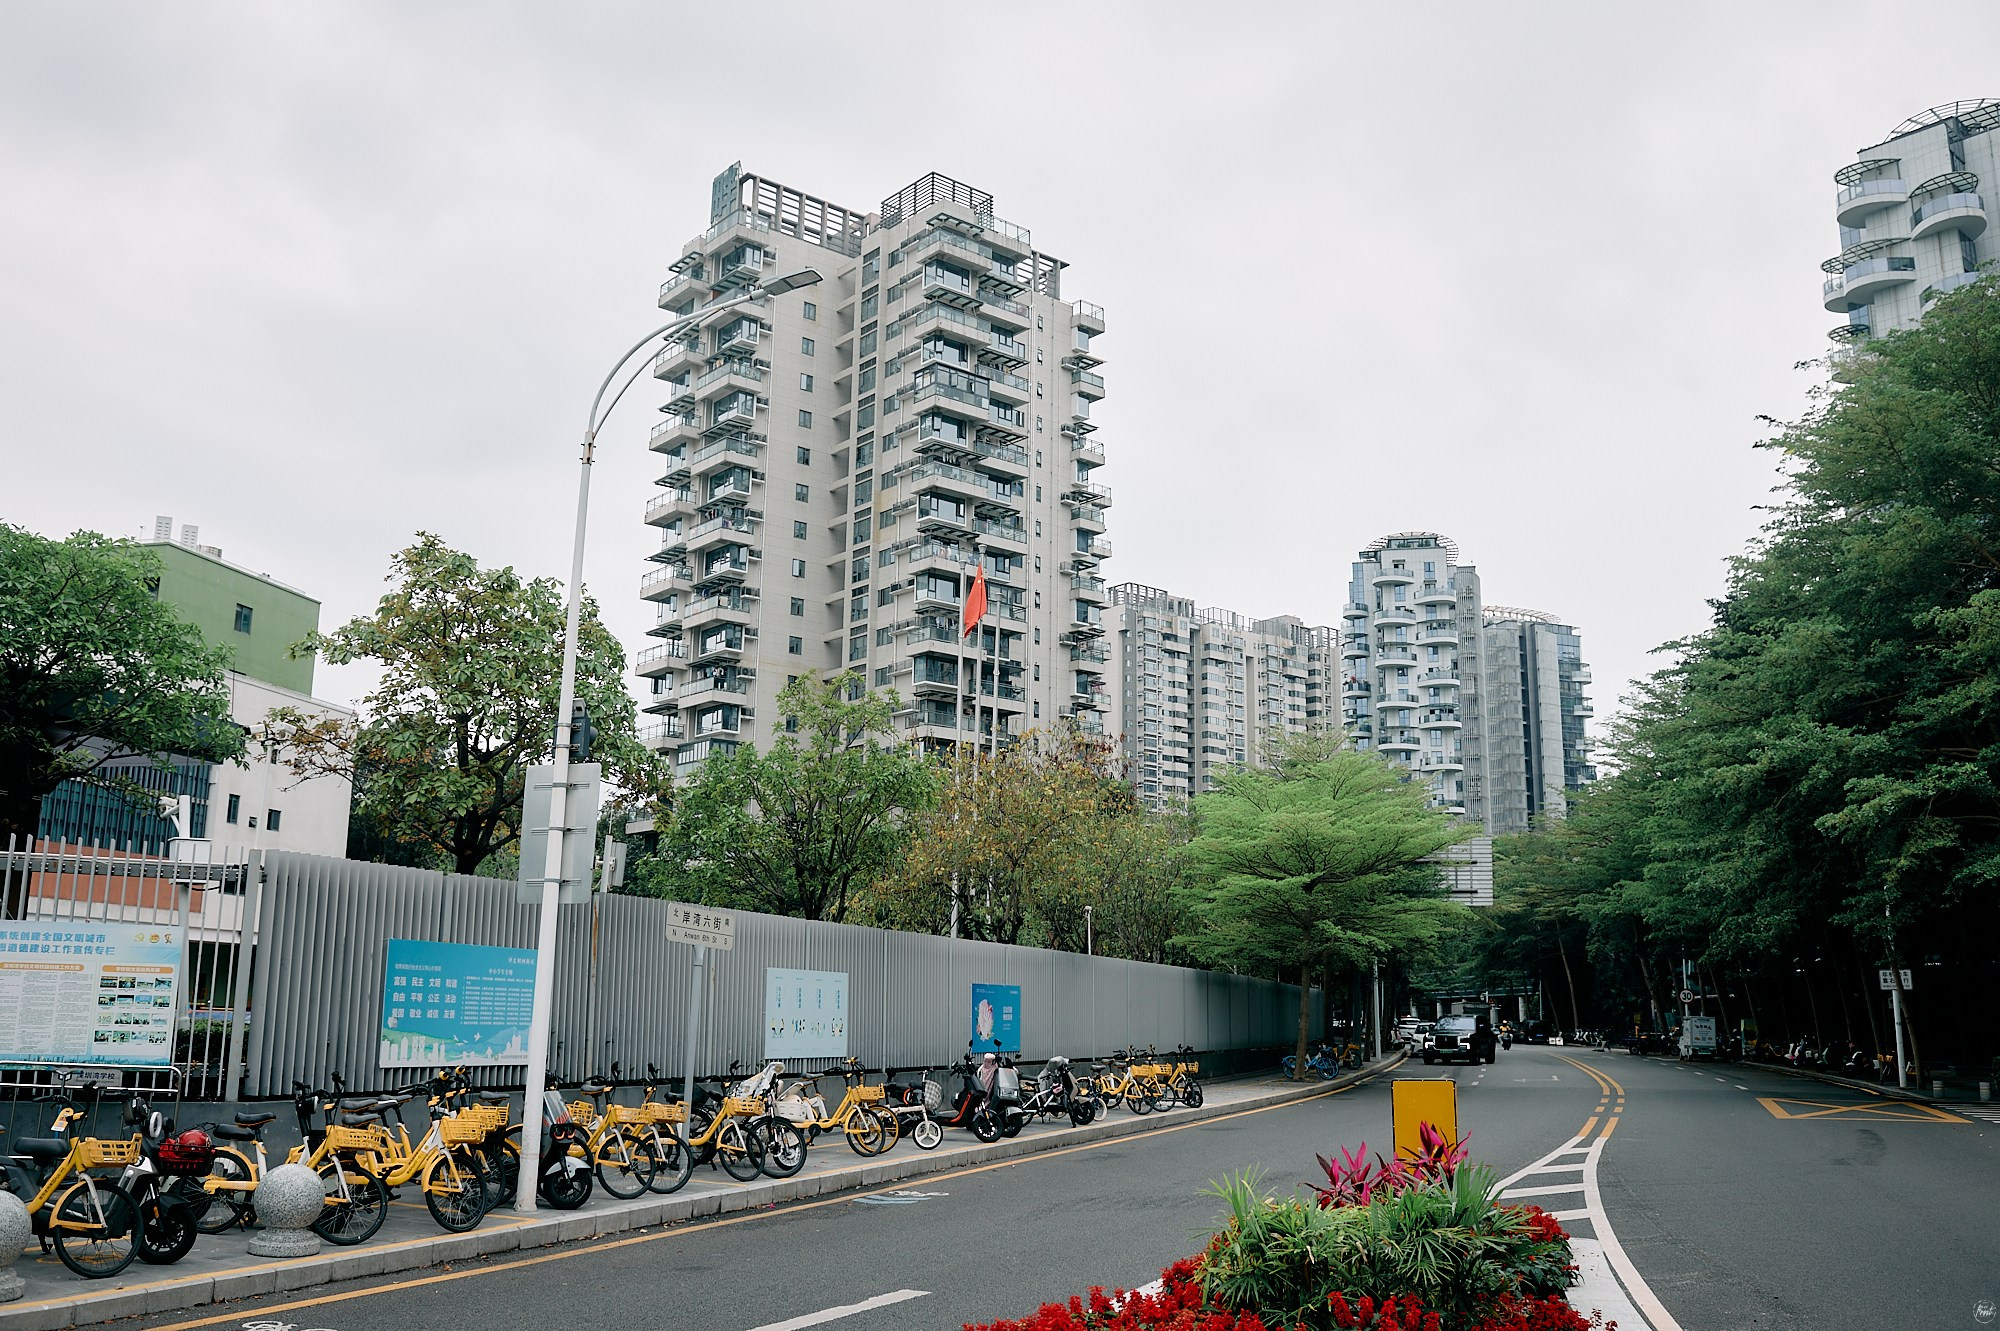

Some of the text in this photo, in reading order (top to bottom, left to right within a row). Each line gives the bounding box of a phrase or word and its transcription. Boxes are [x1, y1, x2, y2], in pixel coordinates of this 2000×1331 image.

[682, 910, 722, 931] 岸湾六街
[672, 928, 677, 936] N
[723, 937, 728, 945] S
[411, 976, 424, 987] 民主
[428, 993, 440, 1003] 公正
[1681, 991, 1692, 1001] 30
